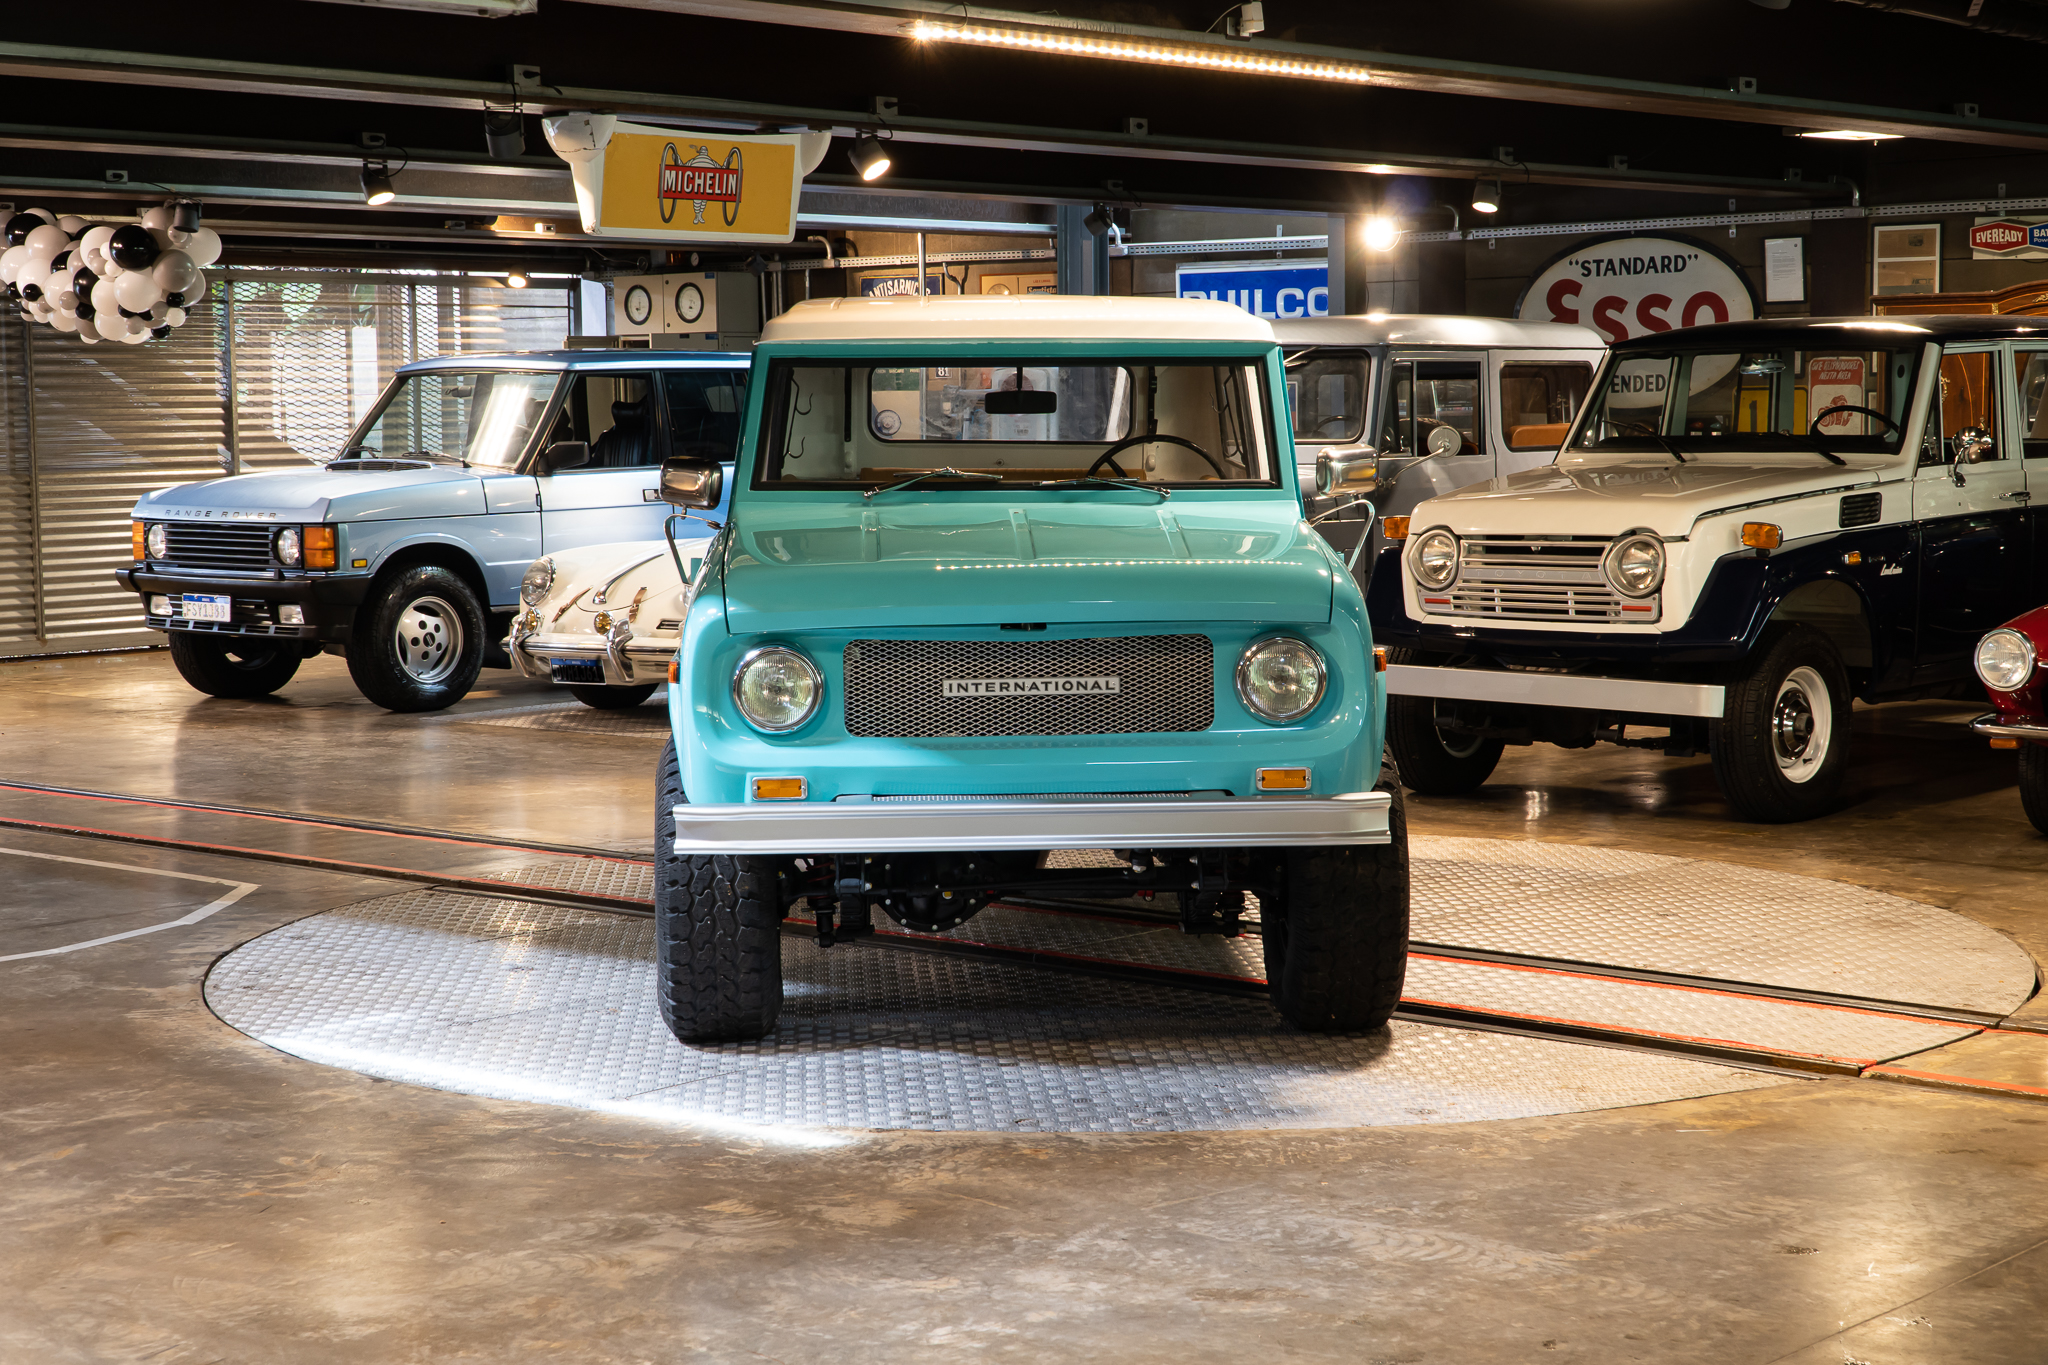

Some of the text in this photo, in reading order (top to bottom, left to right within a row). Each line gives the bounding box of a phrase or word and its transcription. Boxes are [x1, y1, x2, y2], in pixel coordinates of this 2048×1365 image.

[664, 170, 737, 196] MICHELIN
[1976, 228, 2023, 243] EVEREADY
[165, 509, 276, 519] RANGE ROVER
[1475, 568, 1591, 580] TOYOTA
[948, 680, 1116, 693] INTERNATIONAL
